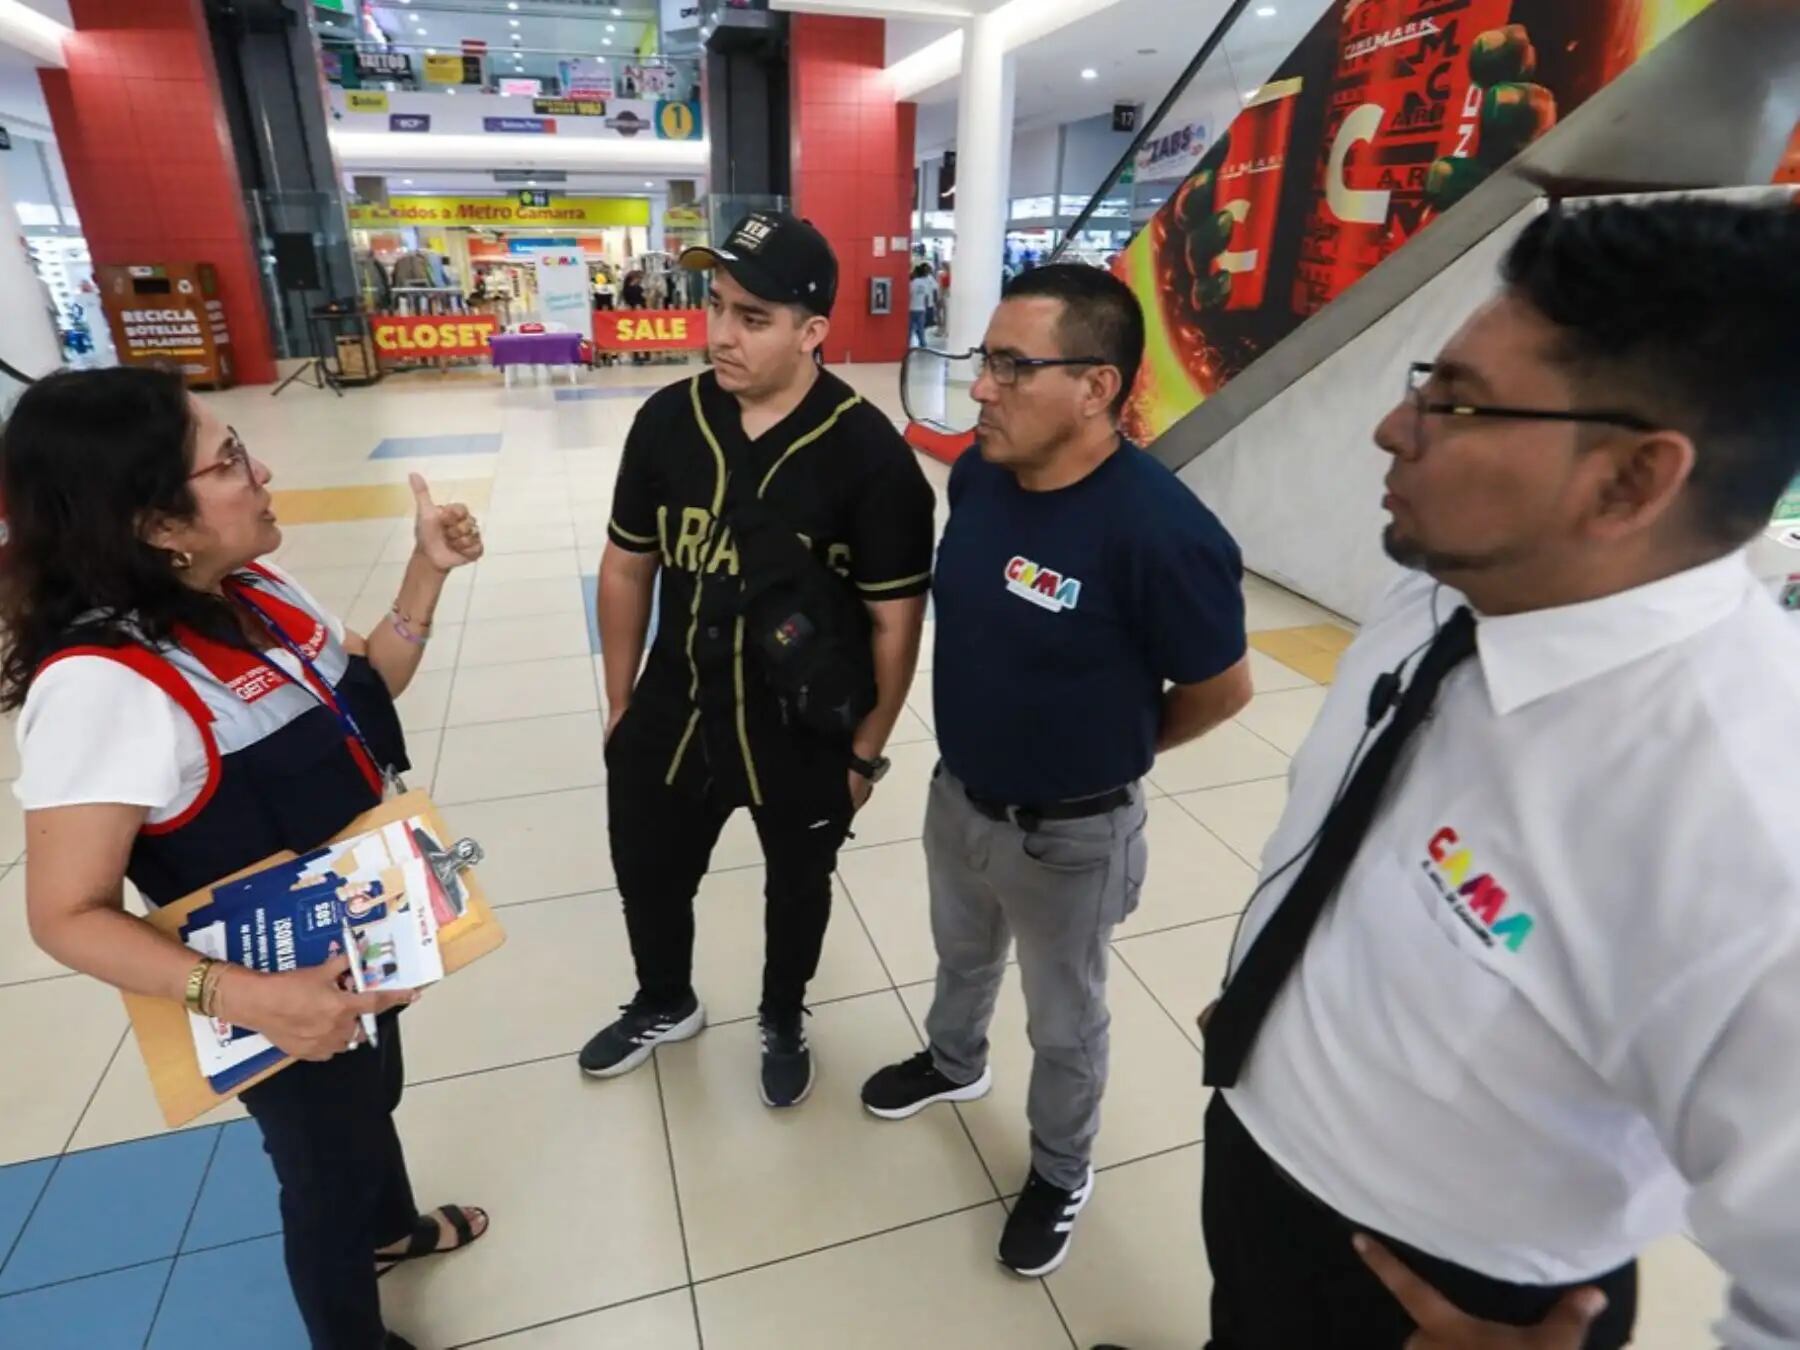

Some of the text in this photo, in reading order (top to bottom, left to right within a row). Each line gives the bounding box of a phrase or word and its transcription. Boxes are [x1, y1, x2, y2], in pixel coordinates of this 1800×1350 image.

[1344, 17, 1440, 59] CINEMARK
[456, 203, 513, 219] Metro
[120, 309, 198, 322] RECICLA
[124, 323, 201, 336] BOTELLAS
[376, 323, 494, 349] CLOSET
[616, 317, 688, 341] SALE
[1427, 826, 1533, 953] CAMA
